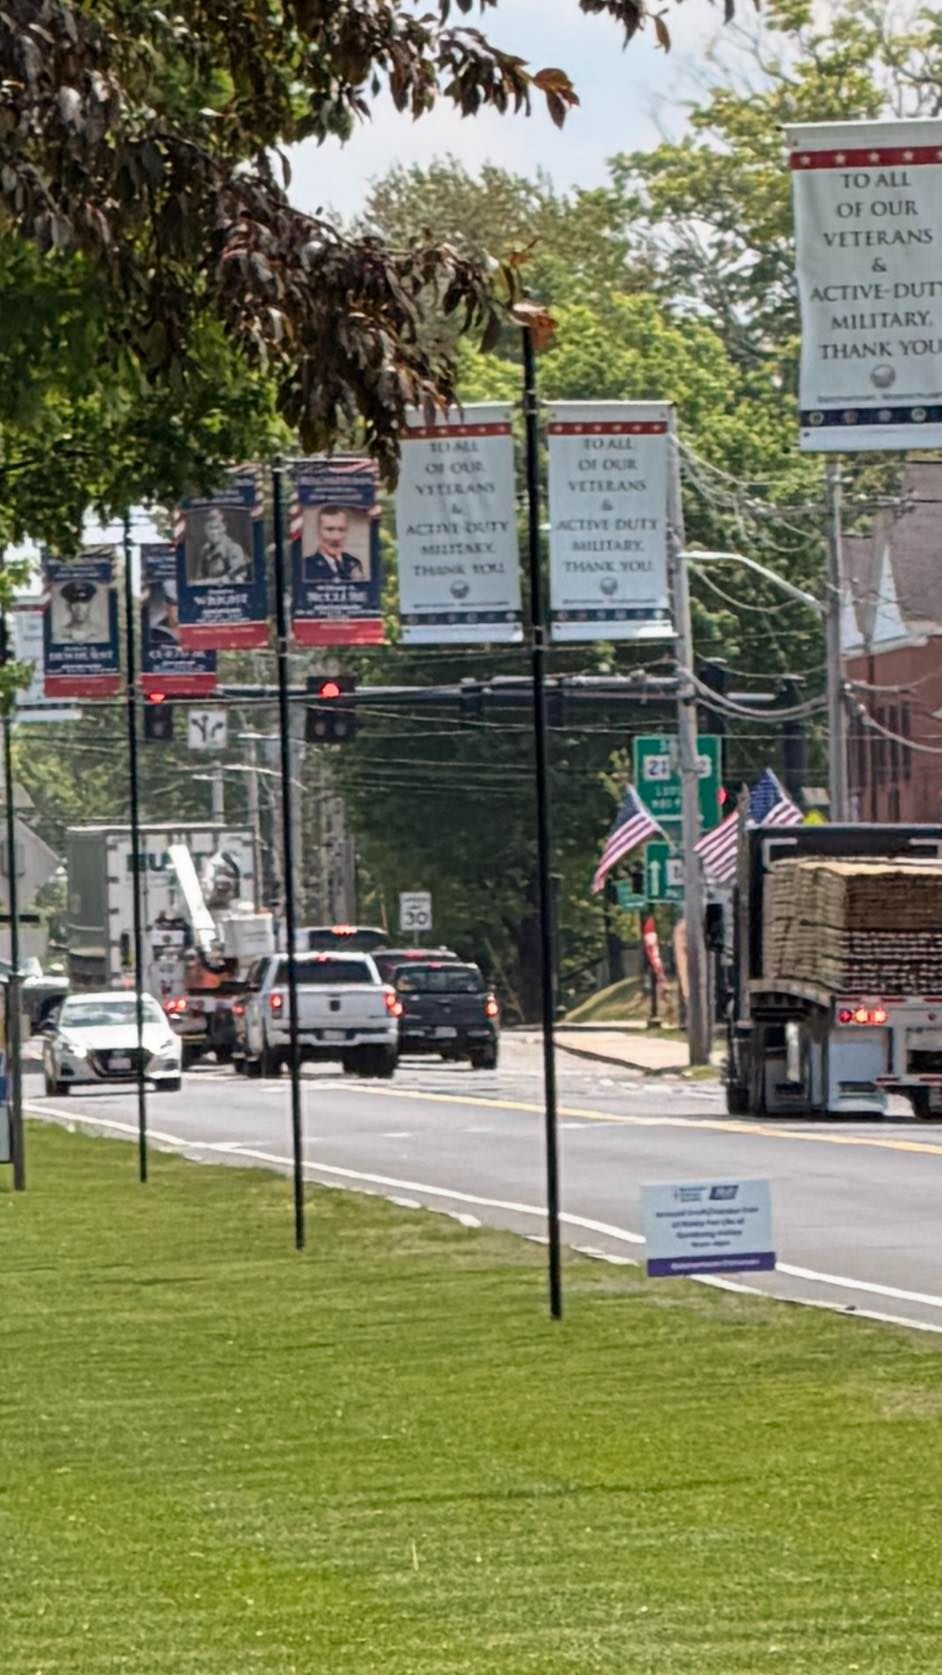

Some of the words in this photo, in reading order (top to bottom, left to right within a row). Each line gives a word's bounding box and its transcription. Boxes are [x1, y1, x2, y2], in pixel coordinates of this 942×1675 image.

[840, 173, 871, 189] TO
[876, 171, 911, 188] ALL
[835, 202, 863, 219] OF
[871, 200, 919, 217] OUR
[822, 228, 933, 248] VETERANS
[871, 257, 888, 273] &
[818, 342, 893, 361] THANK
[429, 441, 450, 453] TO
[453, 440, 478, 453] ALL
[583, 438, 604, 450] TO
[607, 437, 633, 450] ALL
[425, 462, 445, 475] OF
[450, 461, 484, 474] OUR
[578, 459, 597, 471] OF
[602, 458, 637, 471] OUR
[415, 482, 496, 496] VETERANS
[568, 479, 647, 492] VETERANS
[413, 564, 466, 576] THANK
[564, 560, 616, 573] THANK
[404, 910, 430, 926] 30
